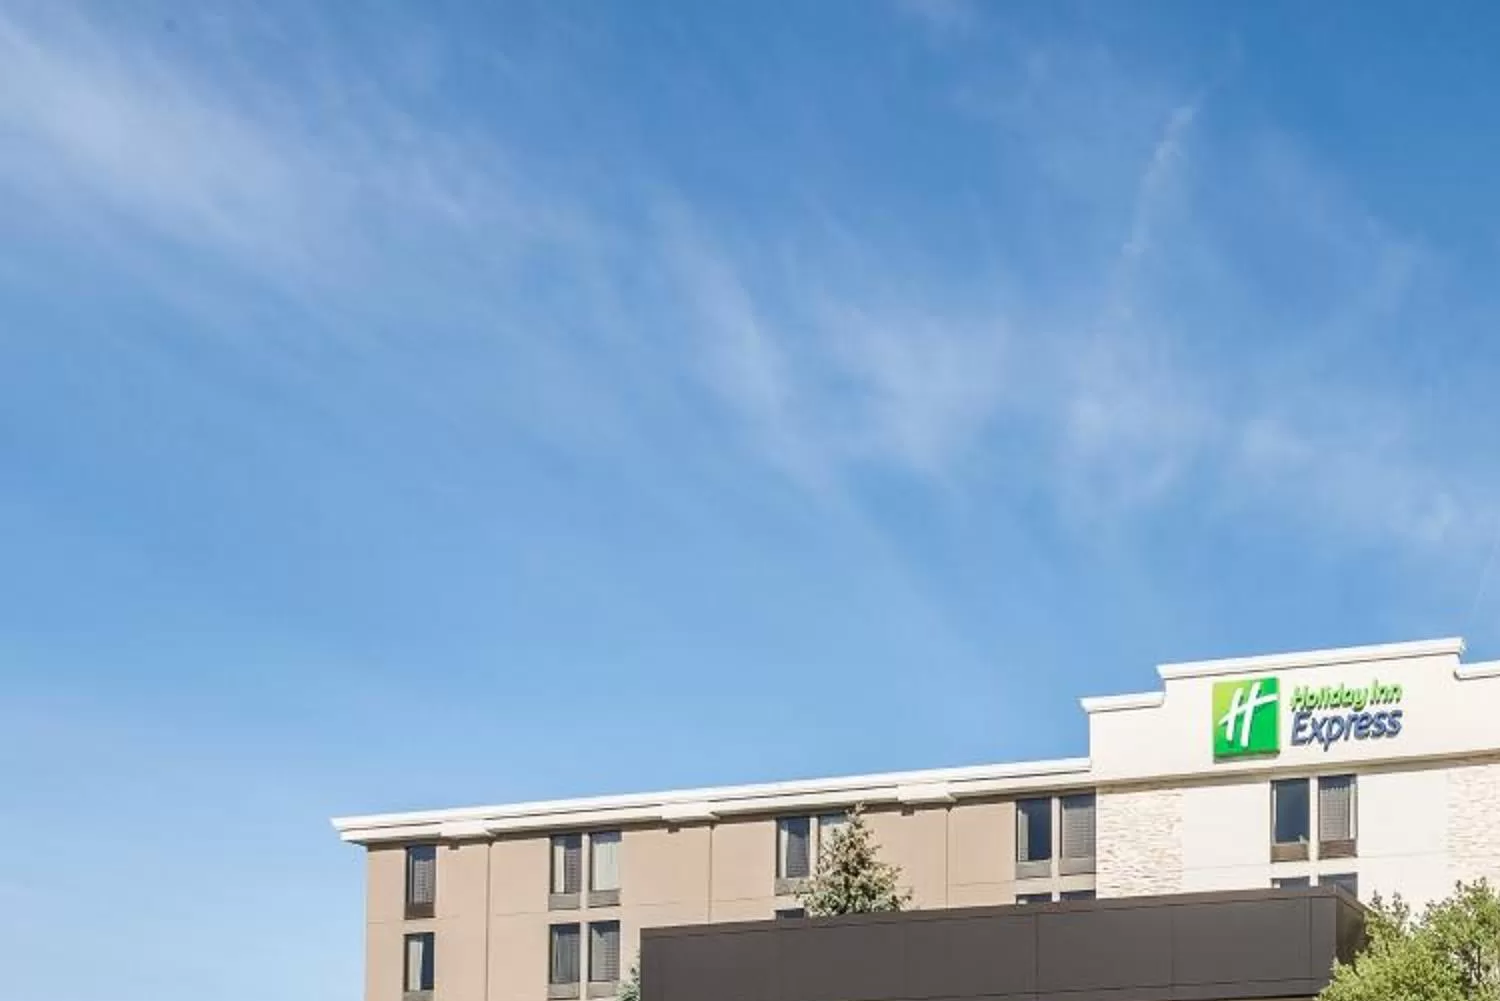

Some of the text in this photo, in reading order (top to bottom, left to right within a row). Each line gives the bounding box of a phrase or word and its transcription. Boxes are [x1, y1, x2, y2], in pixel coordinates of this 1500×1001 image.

[1291, 679, 1402, 712] Holiday Inn
[1291, 710, 1403, 752] Express
